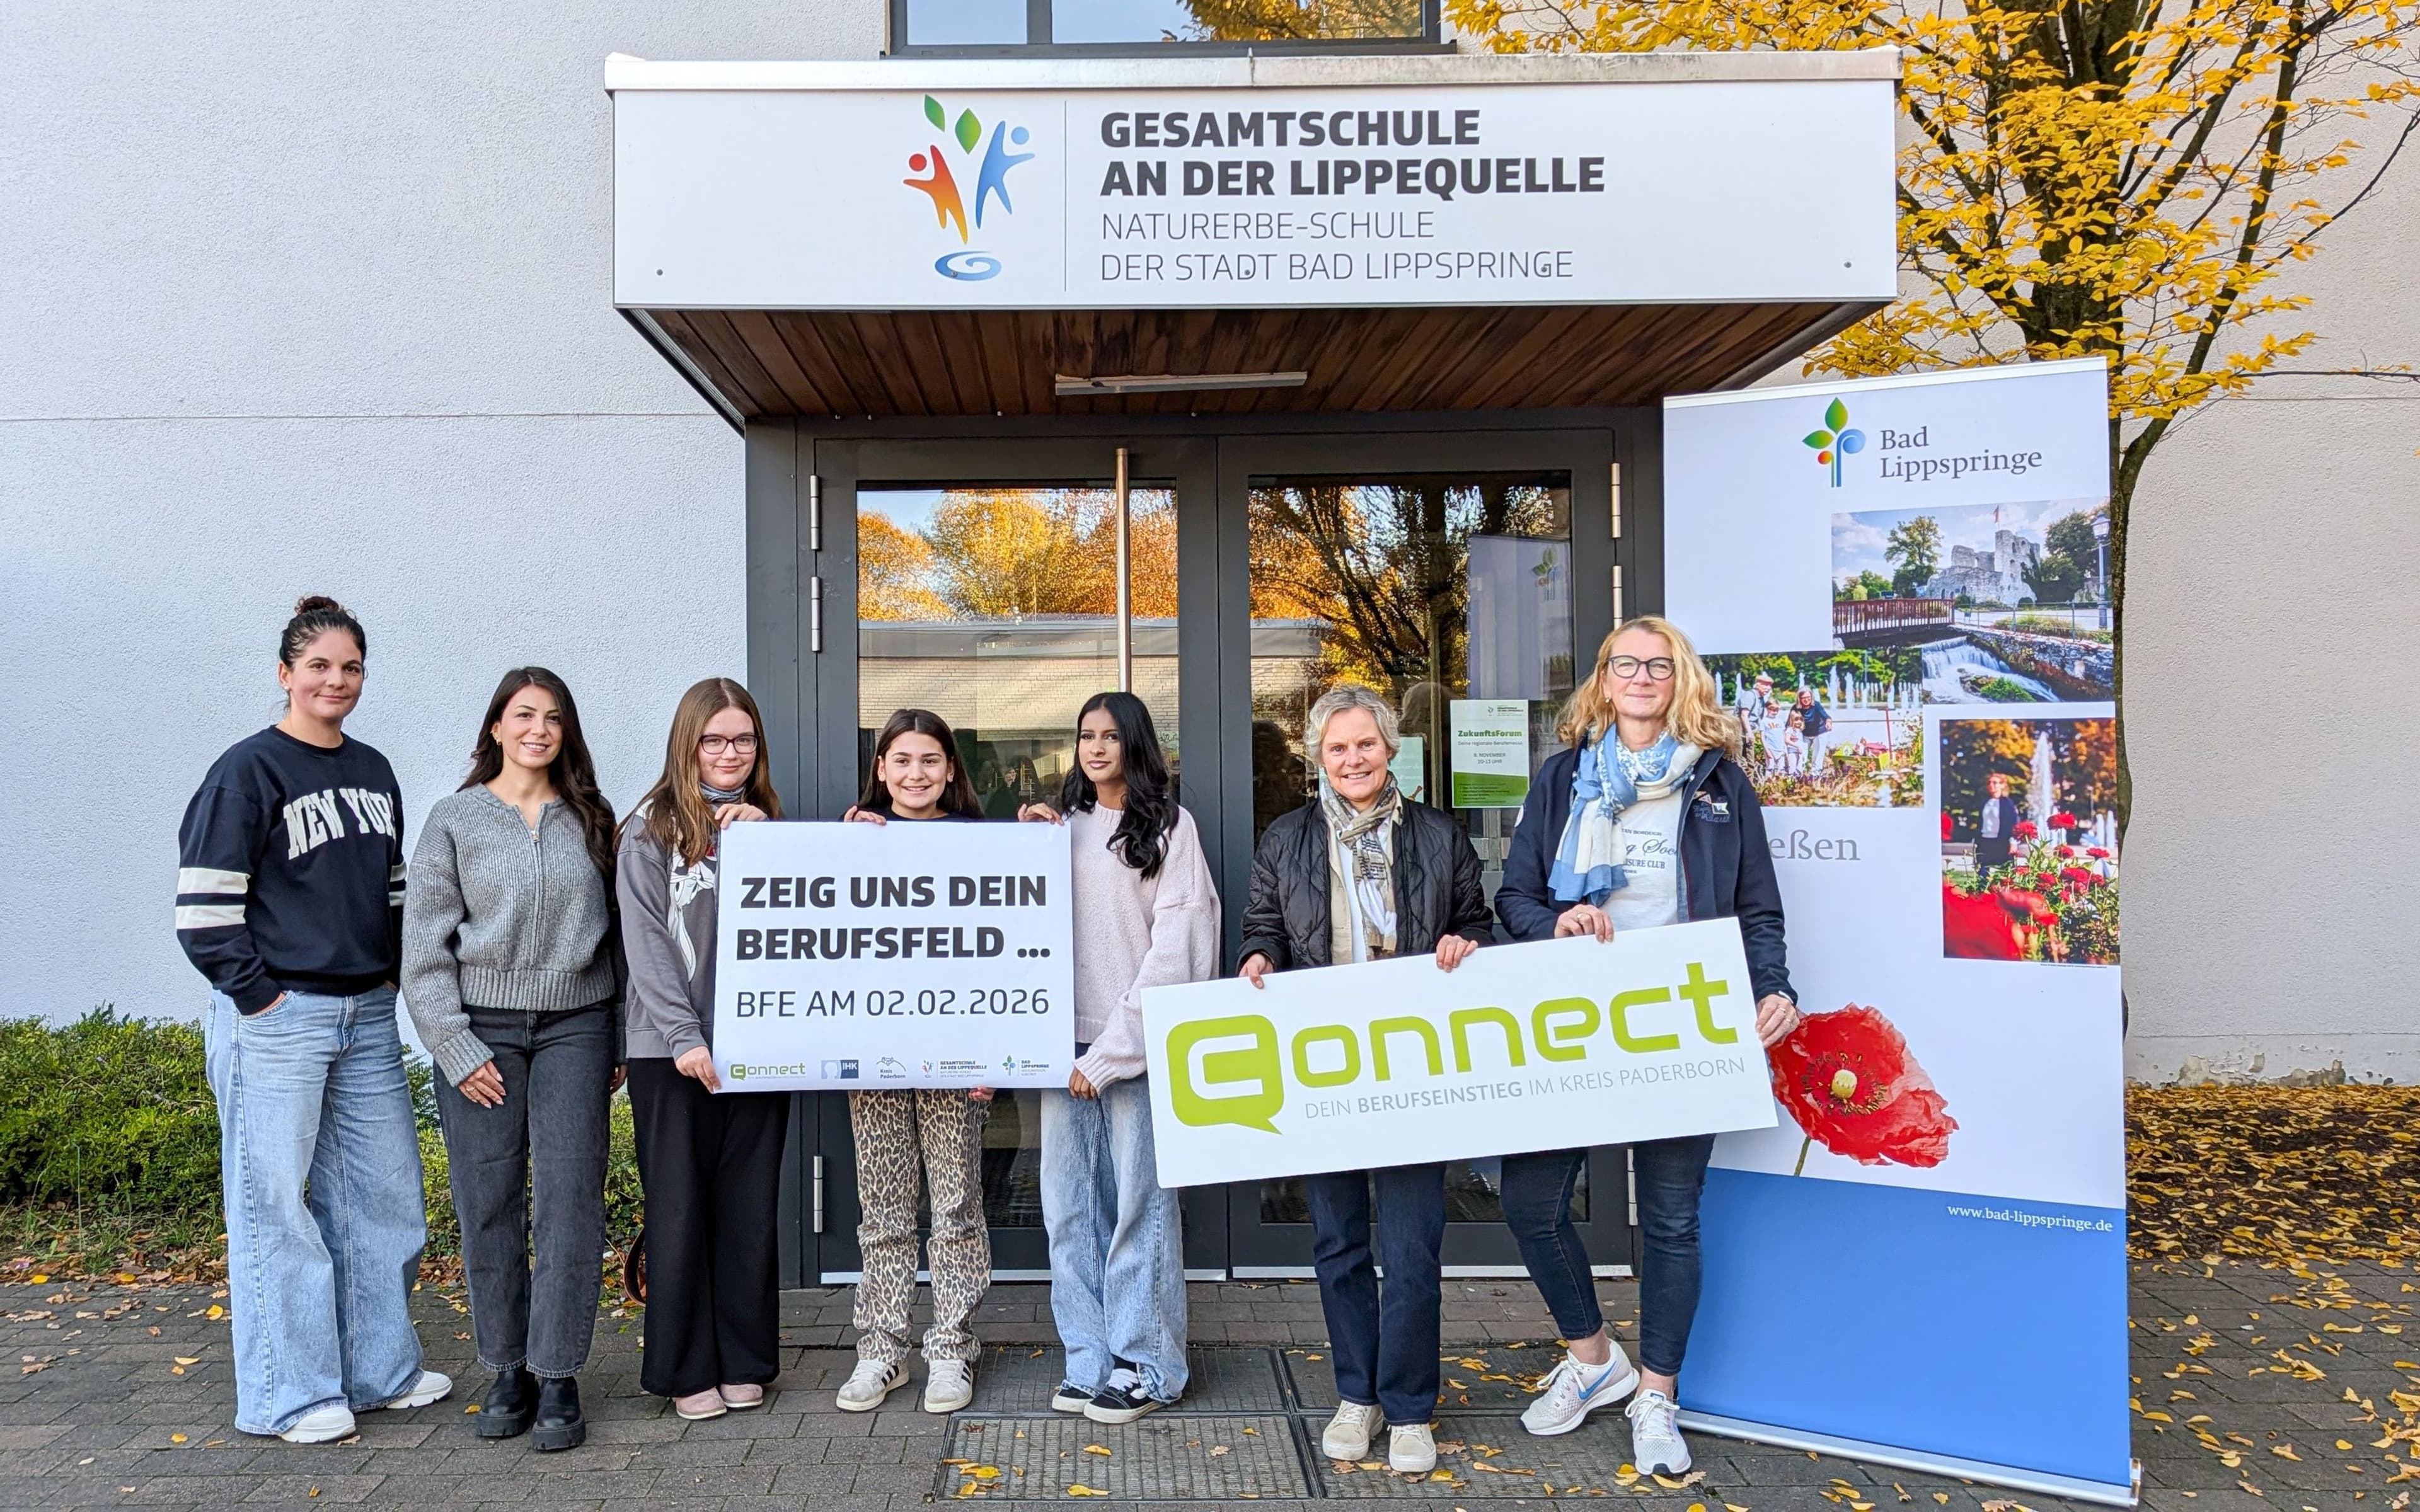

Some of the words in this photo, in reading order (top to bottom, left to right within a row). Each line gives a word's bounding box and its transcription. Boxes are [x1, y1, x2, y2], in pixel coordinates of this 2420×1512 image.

[1101, 110, 1480, 148] GESAMTSCHULE
[1100, 161, 1167, 197] AN
[1183, 160, 1275, 196] DER
[1290, 156, 1605, 202] LIPPEQUELLE
[1103, 211, 1434, 240] NATURERBE-SCHULE
[1102, 254, 1163, 280] DER
[1175, 253, 1277, 281] STADT
[1289, 253, 1353, 280] BAD
[1366, 251, 1573, 280] LIPPSPRINGE
[1880, 425, 1930, 450] Bad
[1880, 449, 2043, 482] Lippspringe
[283, 789, 345, 860] NEW
[1647, 860, 1665, 869] CLUB
[740, 876, 836, 908] ZEIG
[850, 876, 935, 908] UNS
[948, 875, 1046, 907] DEIN
[736, 927, 1005, 961] BERUFSFELD
[1017, 948, 1051, 958] ...
[737, 991, 796, 1017] BFE
[805, 990, 855, 1017] AM
[867, 988, 1049, 1016] 02.02.2026
[1166, 961, 1739, 1135] Connect
[730, 1062, 806, 1080] Connect
[842, 1062, 858, 1070] IHK
[1305, 1099, 1352, 1119] DEIN
[1358, 1081, 1523, 1114] BERUFSEINSTIEG
[1528, 1078, 1555, 1096] IM
[1560, 1070, 1615, 1093] KREIS
[1619, 1057, 1746, 1087] PADERBORN
[1947, 1206, 2112, 1232] www.bad-lippspringe.de
